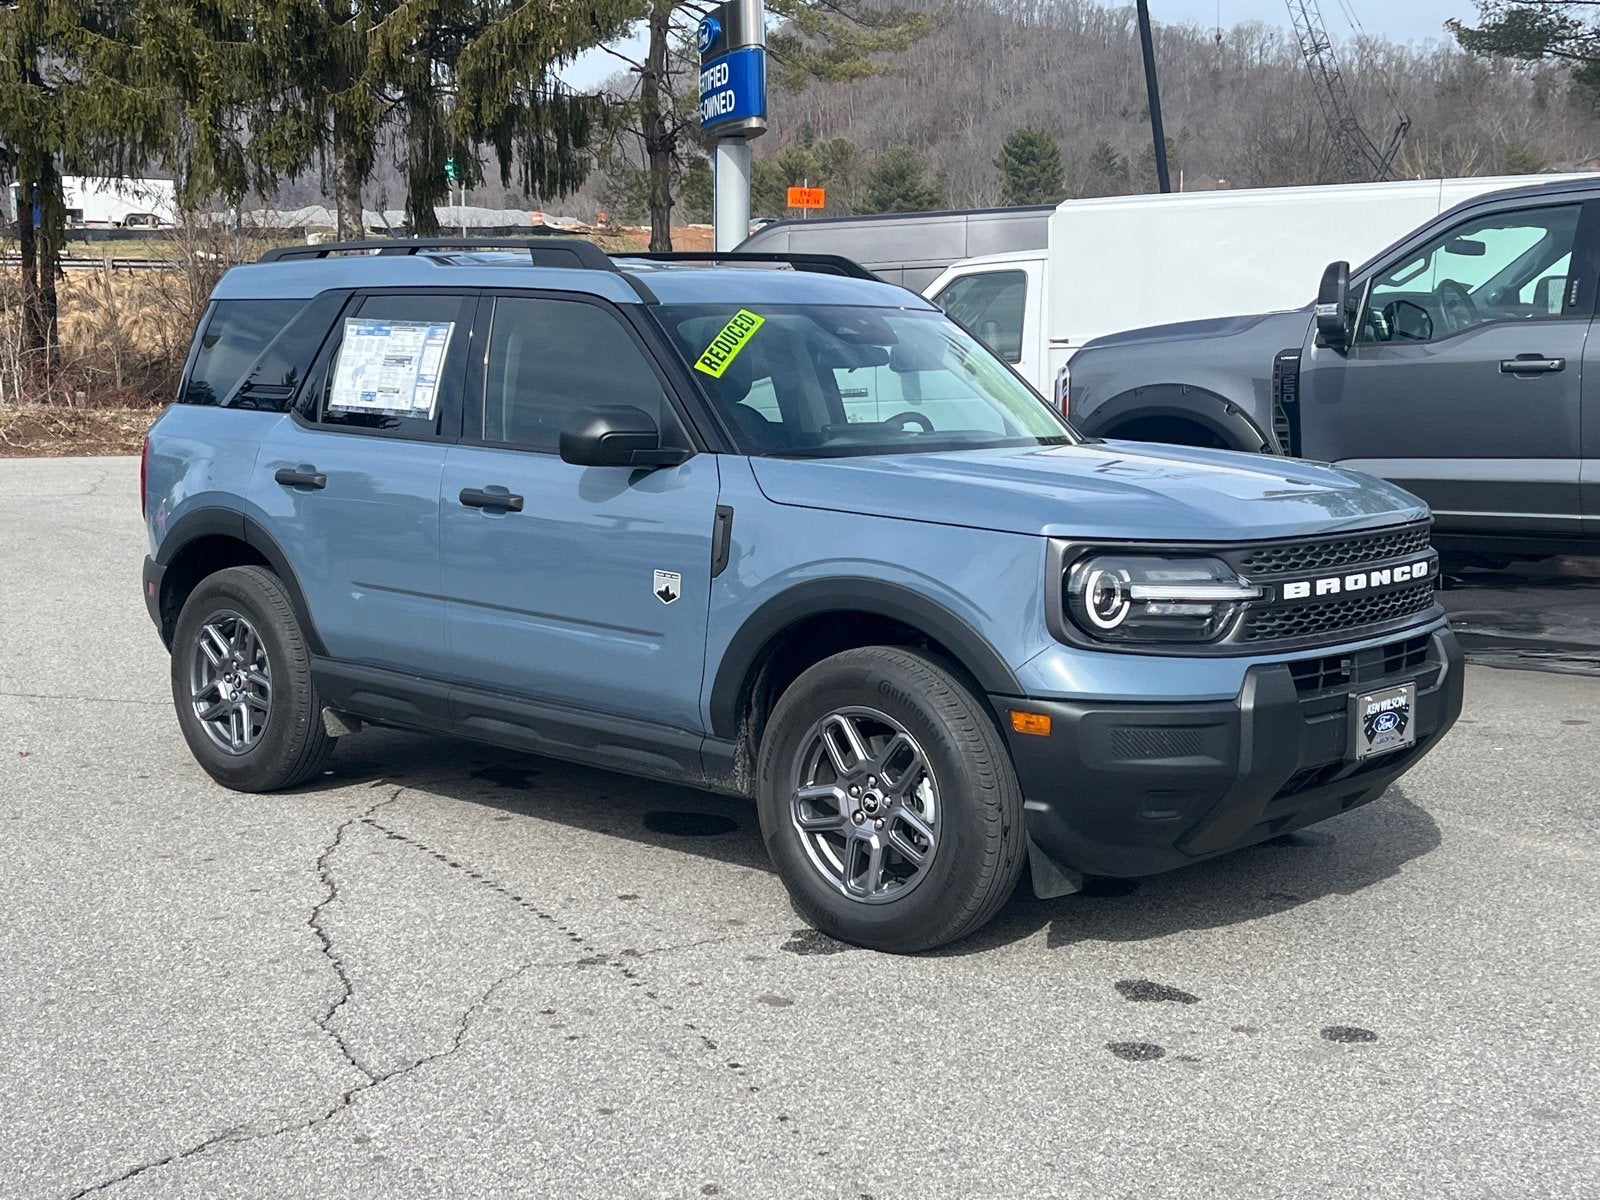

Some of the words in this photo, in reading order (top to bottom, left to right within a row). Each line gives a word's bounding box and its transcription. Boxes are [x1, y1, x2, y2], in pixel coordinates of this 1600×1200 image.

[700, 313, 756, 372] REDUCED
[1283, 561, 1428, 600] BRONCO
[1367, 701, 1381, 715] KEN
[1380, 695, 1407, 711] WILSON
[1377, 715, 1395, 732] Ford
